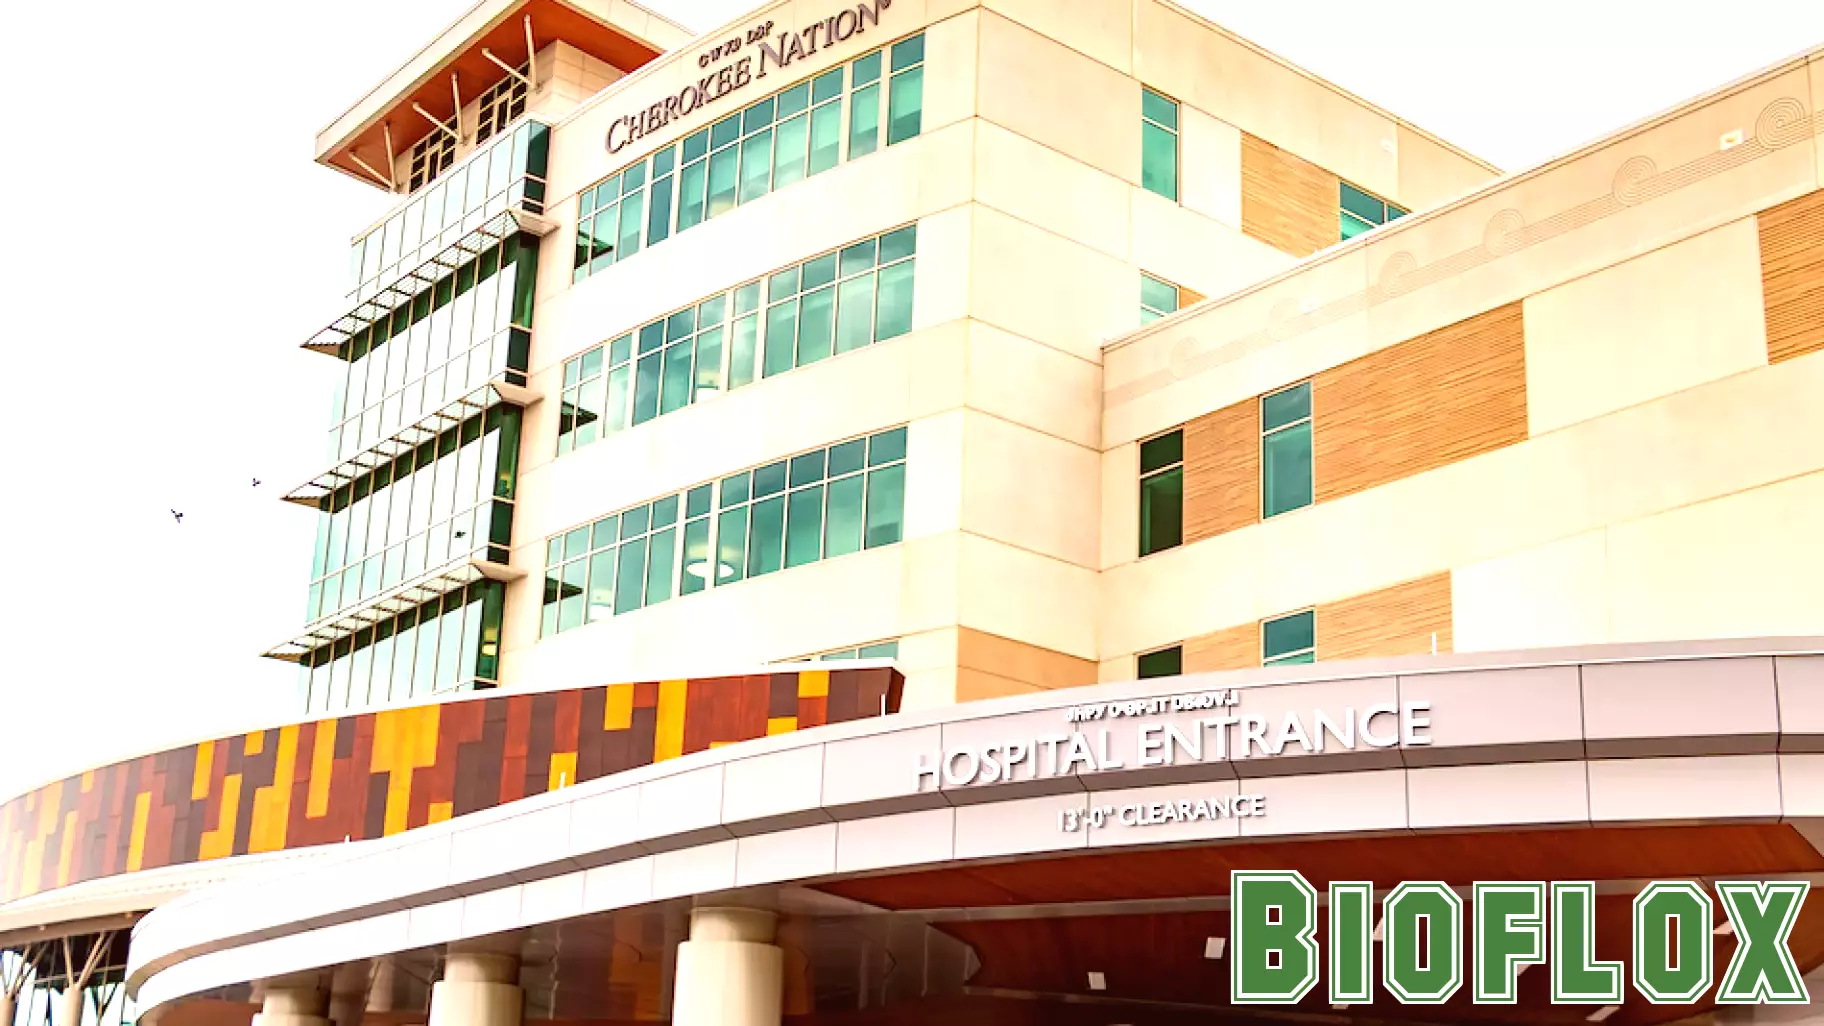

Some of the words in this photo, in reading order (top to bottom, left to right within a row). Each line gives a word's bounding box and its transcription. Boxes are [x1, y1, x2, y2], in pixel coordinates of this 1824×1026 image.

[605, 55, 752, 154] CHEROKEE
[912, 729, 1124, 793] HOSPITAL
[1137, 701, 1434, 767] ENTRANCE
[1118, 794, 1267, 827] CLEARANCE
